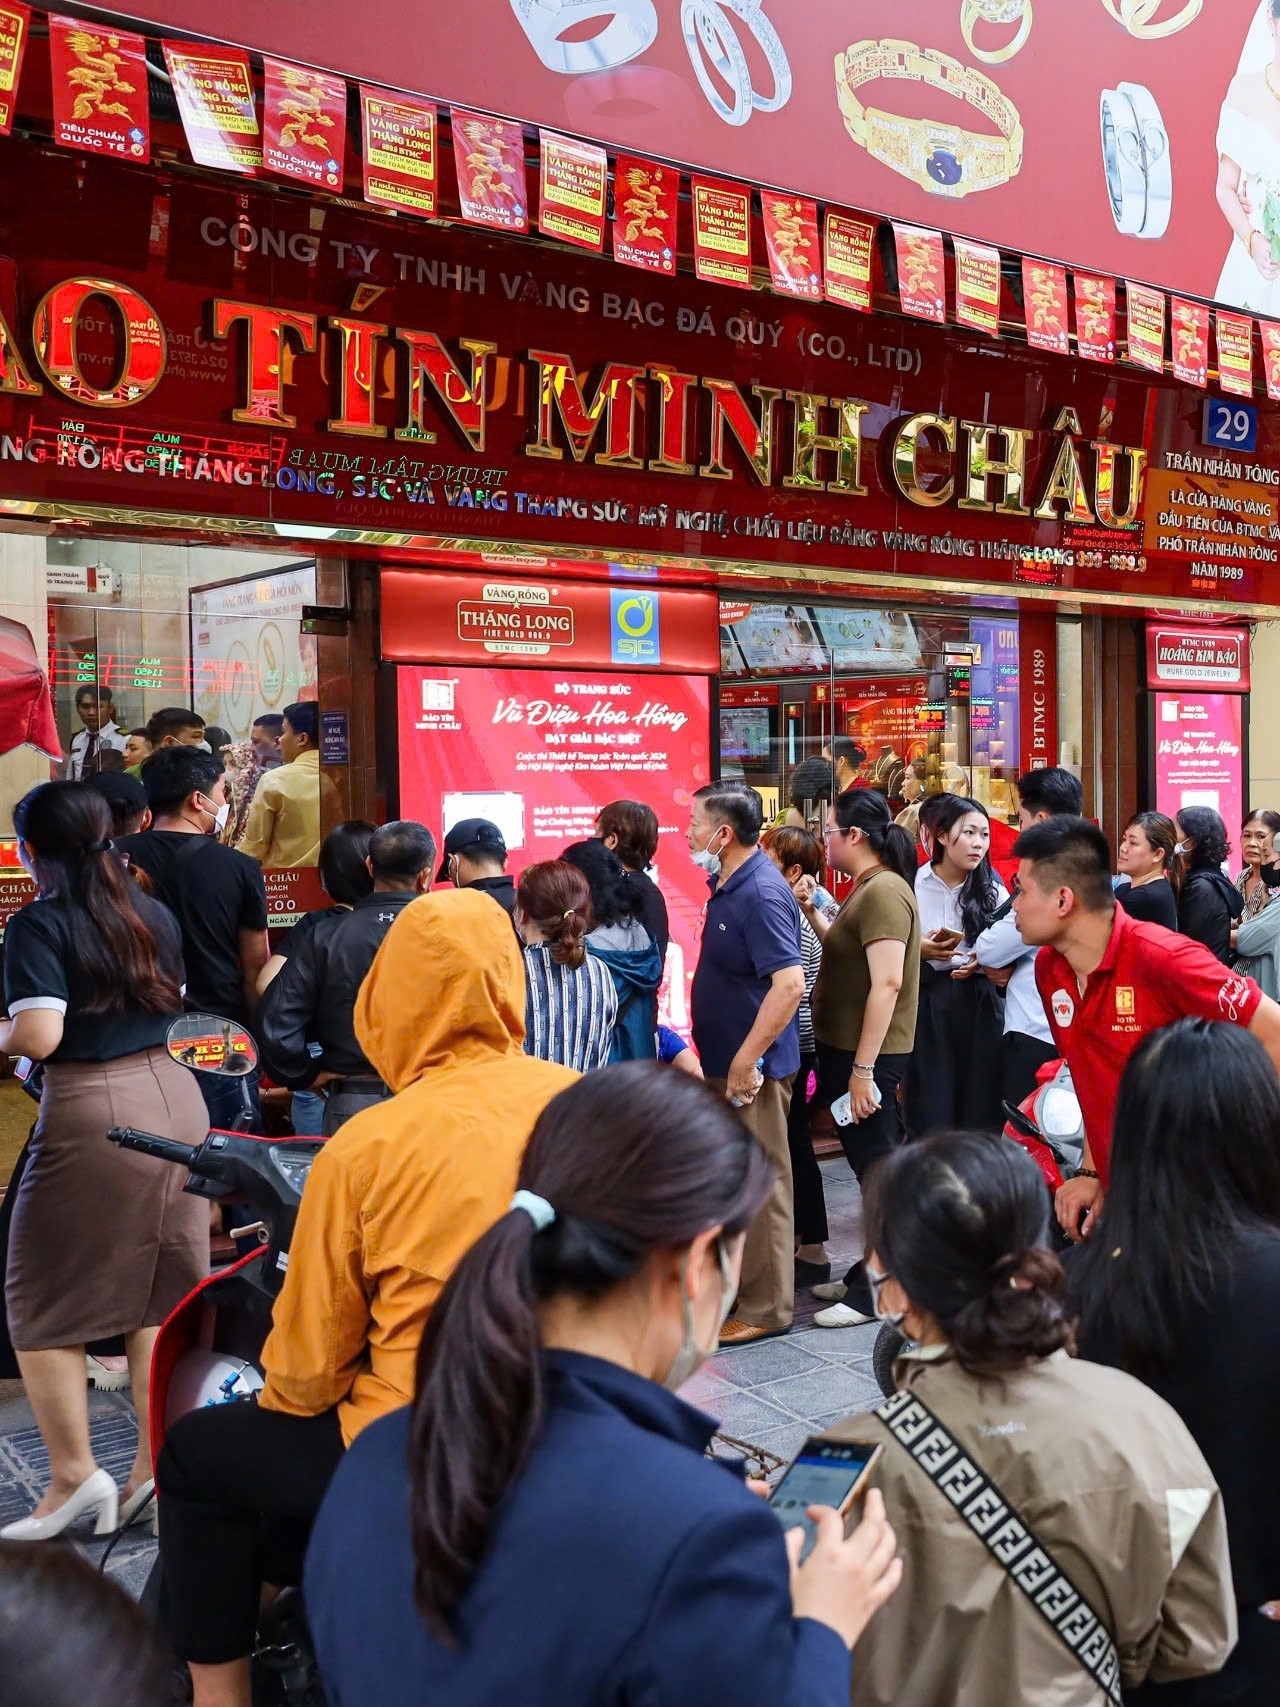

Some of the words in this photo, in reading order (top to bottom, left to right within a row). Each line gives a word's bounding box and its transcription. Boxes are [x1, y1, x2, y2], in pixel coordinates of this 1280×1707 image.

[60, 122, 87, 136] TIÊU
[88, 125, 125, 143] CHUẨN
[371, 117, 400, 132] VÀNG
[60, 132, 103, 147] QUỐC
[110, 139, 125, 152] TẾ
[371, 129, 405, 145] THĂNG
[406, 138, 431, 152] LONG
[268, 149, 291, 162] TIÊU
[290, 153, 323, 172] CHUẨN
[399, 148, 421, 159] BTMC
[548, 156, 574, 171] VÀNG
[268, 158, 302, 175] QUỐC
[307, 165, 322, 181] TẾ
[579, 178, 601, 191] LONG
[700, 204, 722, 216] VÀNG
[726, 221, 746, 231] LONG
[200, 214, 318, 263] CÔNG
[330, 240, 380, 275] TY
[394, 252, 486, 295] TNHH
[500, 271, 590, 313] VÀNG
[602, 292, 666, 329] BẠC
[676, 305, 716, 337] ĐÁ
[725, 315, 784, 349] QUÝ
[868, 342, 923, 377] LTD)
[213, 281, 502, 453] TÍN
[526, 347, 877, 496] MINH
[893, 405, 1147, 529] CHÂU
[1215, 406, 1251, 443] 29
[1165, 450, 1202, 474] TRẦN
[1205, 459, 1242, 480] NHÂN
[1245, 463, 1280, 486] TÔNG
[57, 434, 146, 474] RỒNG
[157, 451, 253, 486] THĂNG
[404, 476, 436, 505] VÀ
[444, 481, 509, 512] VÀNG
[514, 491, 589, 519] TRANG
[591, 498, 634, 524] SỨC
[638, 503, 671, 528] MỸ
[675, 508, 730, 539] NGHỆ
[733, 511, 784, 540] CHẤT
[787, 517, 826, 547] LIỆU
[828, 519, 878, 549] BẰNG
[882, 525, 928, 555] VÀNG
[930, 530, 976, 559] RỒNG
[1033, 545, 1074, 567] LONG
[1170, 489, 1186, 505] LÀ
[1187, 488, 1208, 508] CỬA
[1210, 491, 1241, 512] HÀNG
[1242, 498, 1271, 518] VÀNG
[1159, 508, 1184, 528] ĐẦU
[1186, 513, 1210, 531] TIÊN
[1212, 516, 1234, 535] CỦA
[1236, 522, 1265, 539] BTMC
[1267, 524, 1280, 540] VÀ
[1158, 534, 1183, 552] PHỐ
[1184, 536, 1214, 555] TRẦN
[1214, 541, 1247, 559] NHÂN
[1248, 546, 1278, 563] TÔNG
[1191, 561, 1218, 578] NĂM
[1219, 566, 1244, 580] 1989
[487, 587, 515, 599] VÀNG
[517, 588, 547, 601] RỒNG
[461, 609, 520, 628] THĂNG
[525, 615, 570, 631] LONG
[483, 629, 501, 637] FINE
[504, 630, 525, 639] GOLD
[1181, 638, 1199, 648] BTMC
[1201, 639, 1216, 648] 1989
[617, 639, 655, 659] SJC
[1160, 644, 1194, 662] HOÀNG
[1196, 648, 1215, 662] KIM
[1217, 646, 1237, 665] BẢO
[1033, 649, 1045, 687] 1989
[1167, 668, 1184, 676] PURE
[1185, 668, 1203, 677] GOLD
[1204, 669, 1231, 678] JEWELRY
[492, 697, 524, 724] Vũ
[526, 699, 580, 728] Điệu
[582, 701, 630, 727] Hoa
[632, 701, 689, 732] Hồng
[1033, 694, 1045, 750] BTMC
[268, 872, 300, 883] CHÂU
[269, 915, 290, 925] NGÀY
